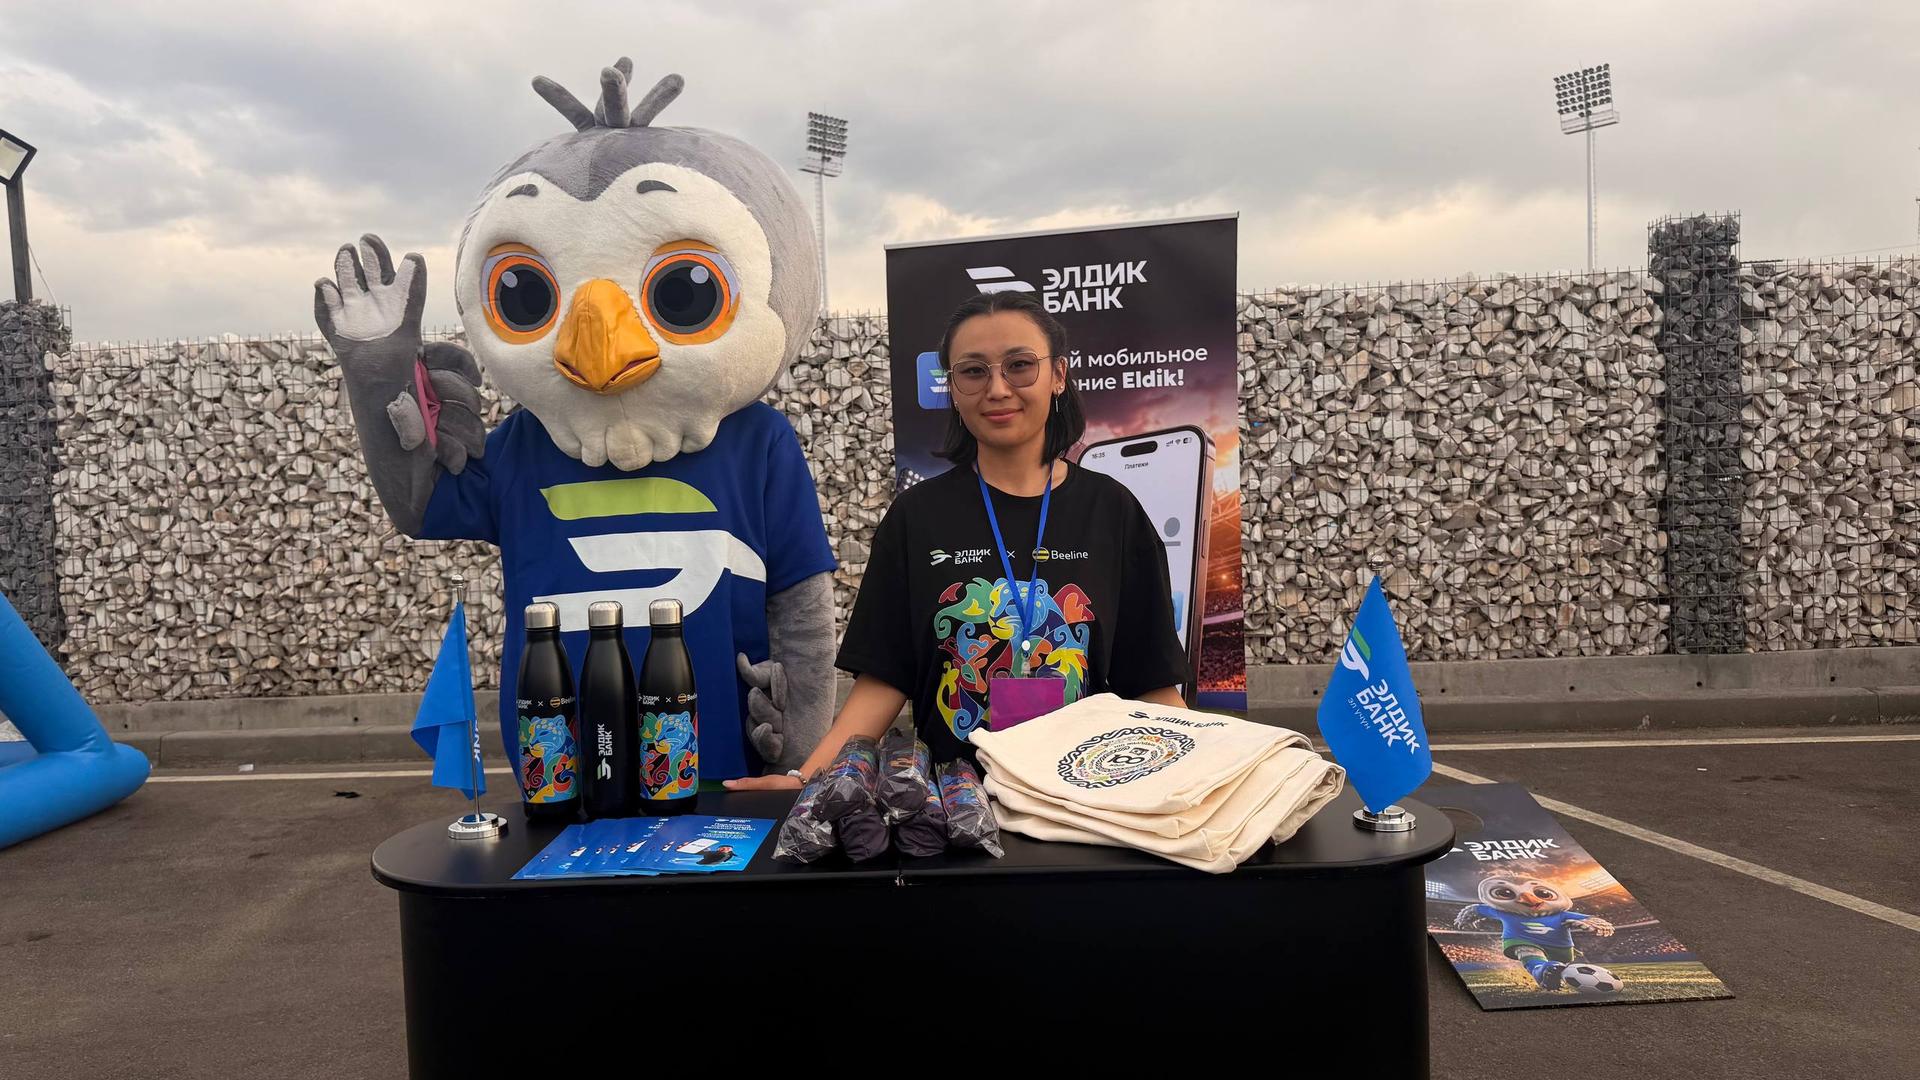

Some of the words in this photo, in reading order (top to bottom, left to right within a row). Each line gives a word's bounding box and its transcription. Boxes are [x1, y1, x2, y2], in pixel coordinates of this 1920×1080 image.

[1042, 260, 1147, 290] ЭЛДИК
[1042, 286, 1124, 313] БАНК
[1088, 347, 1208, 367] мобильное
[1122, 368, 1184, 389] Eldik!
[1124, 462, 1149, 470] Платежи
[954, 549, 991, 558] ЭЛДИК
[954, 556, 983, 565] БАНК
[1051, 550, 1089, 560] Beeline
[1152, 716, 1194, 727] ЭЛДИК
[1356, 687, 1401, 748] БАНК
[1371, 678, 1421, 755] ЭЛДИК
[597, 723, 605, 756] ЭЛДИК
[604, 730, 613, 755] БАНК
[1107, 754, 1145, 764] 100
[1463, 838, 1560, 851] ЭЛДИК
[1472, 848, 1550, 861] БАНК
